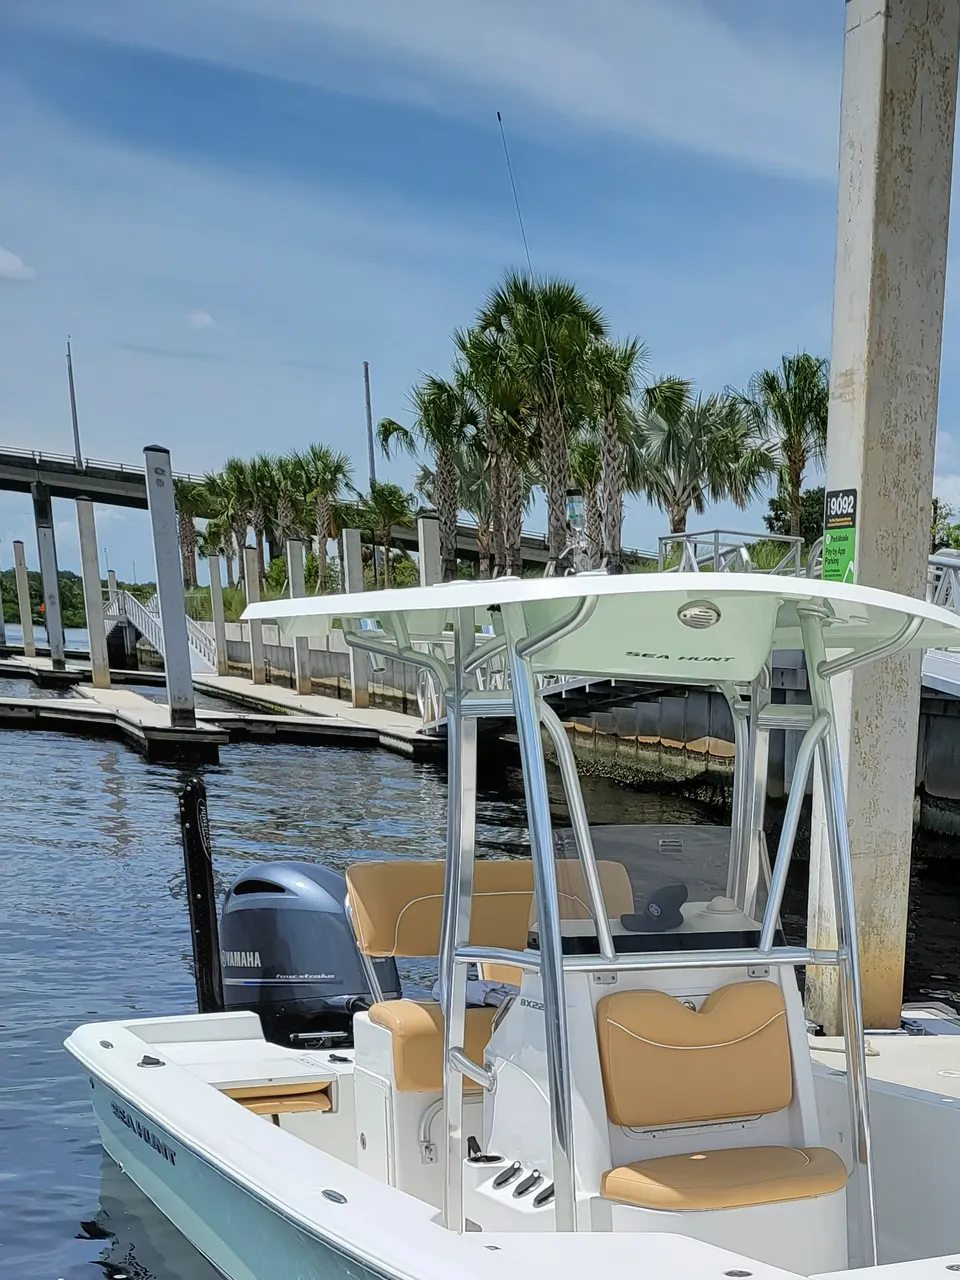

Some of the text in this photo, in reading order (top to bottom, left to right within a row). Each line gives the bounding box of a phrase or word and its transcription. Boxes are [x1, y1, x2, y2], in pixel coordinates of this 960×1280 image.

[825, 557, 839, 566] Parking
[625, 651, 669, 660] SEA
[226, 951, 262, 968] YAMAHA
